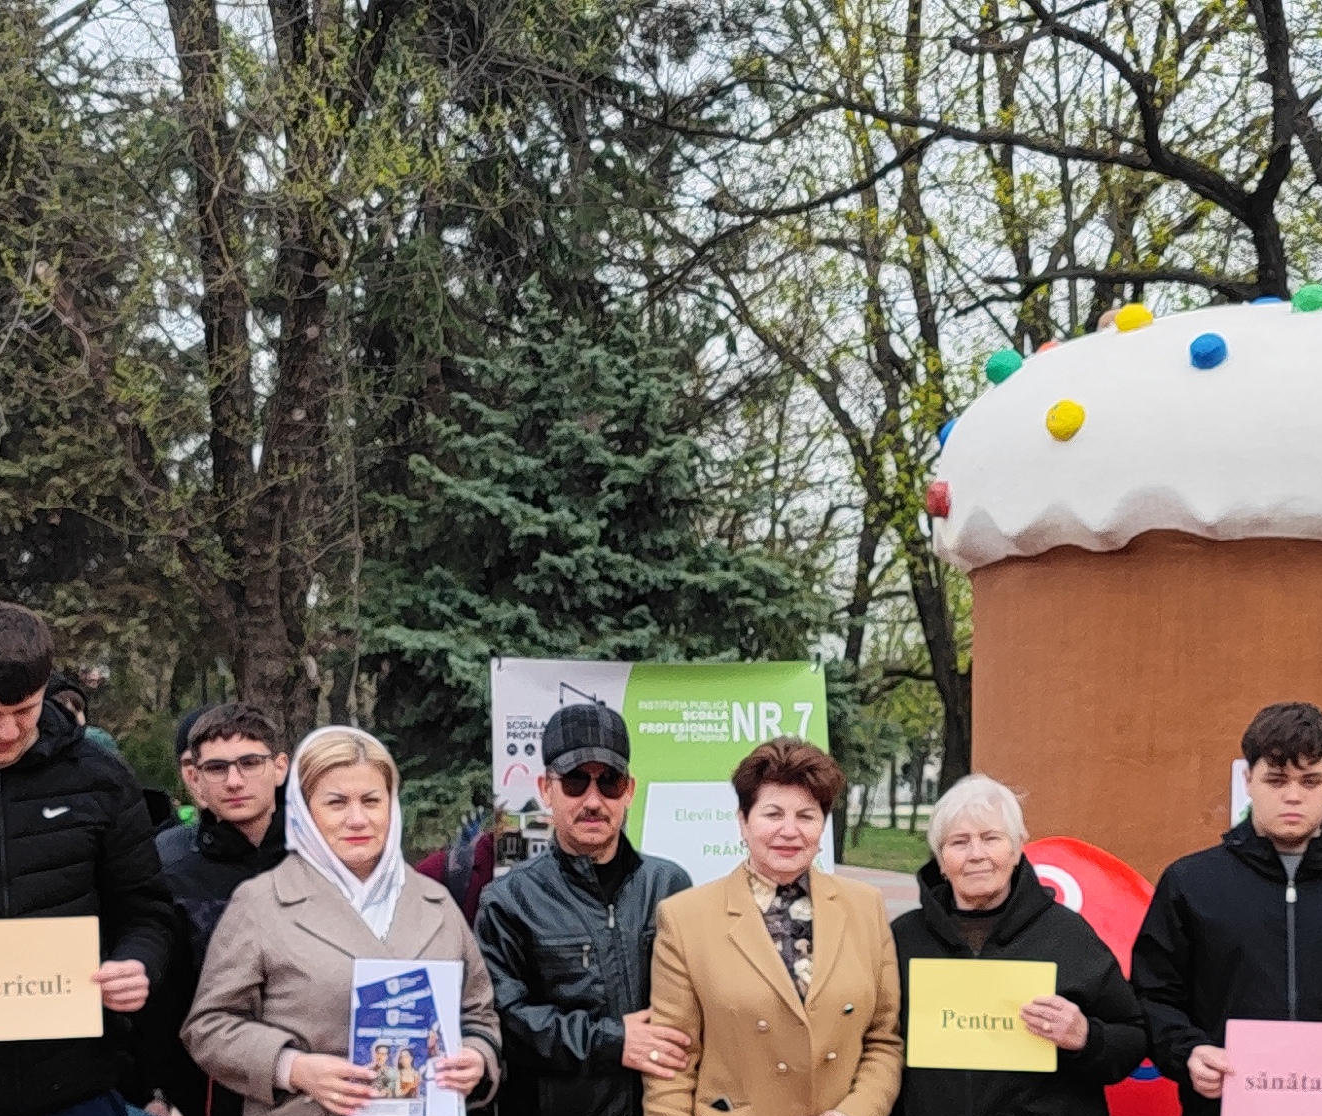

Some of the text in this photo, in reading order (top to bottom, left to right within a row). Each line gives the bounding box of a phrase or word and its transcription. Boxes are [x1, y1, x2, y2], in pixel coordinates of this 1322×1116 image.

[793, 702, 814, 742] 7
[703, 841, 745, 856] PRÂN
[941, 1008, 1015, 1031] Pentru
